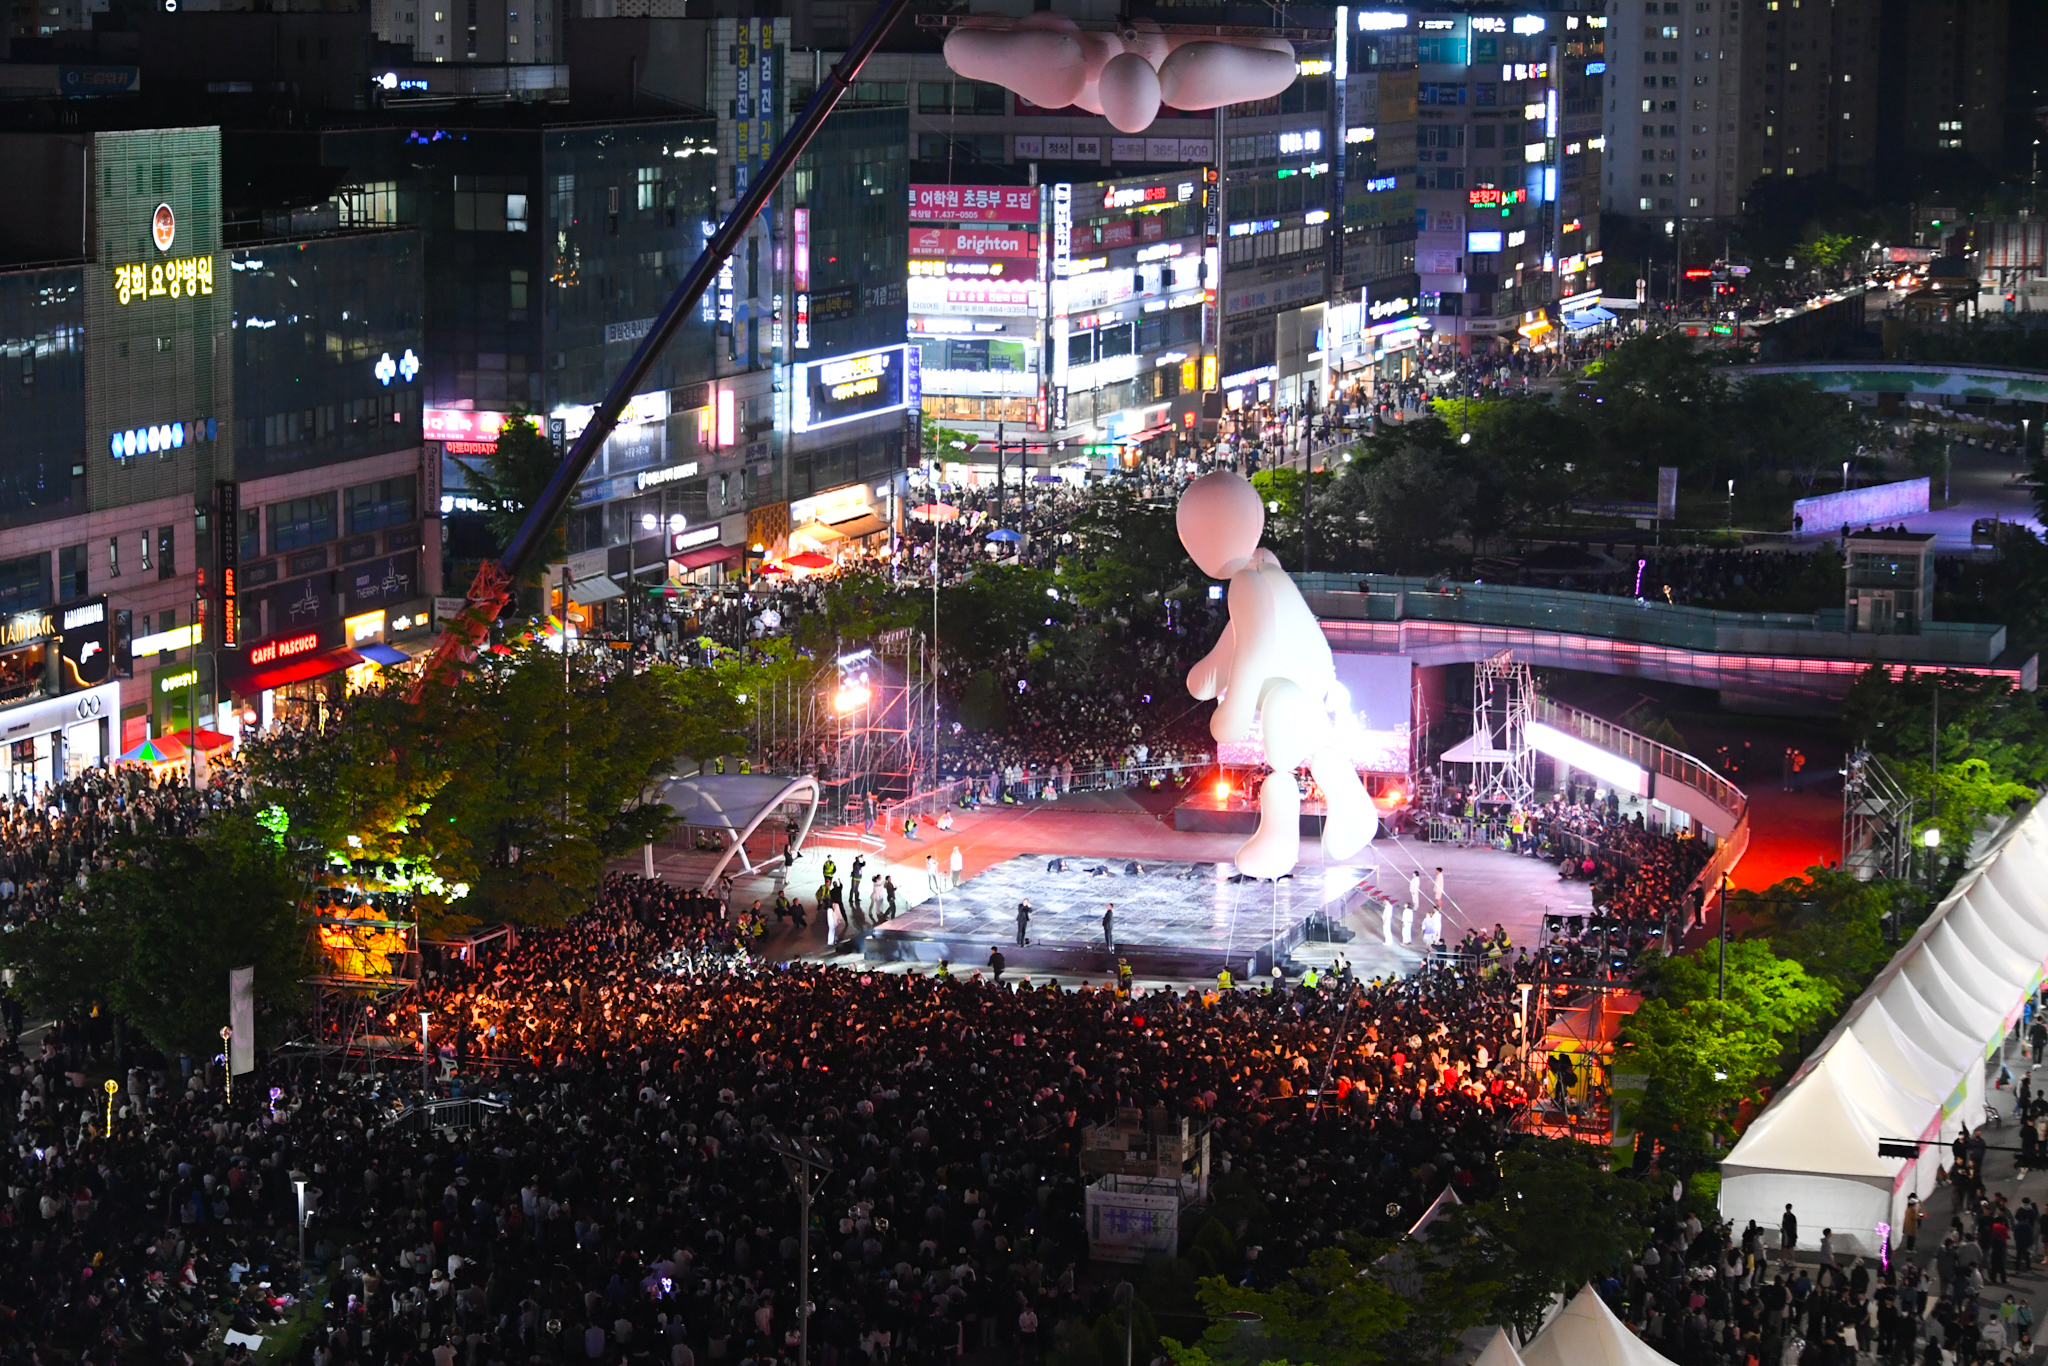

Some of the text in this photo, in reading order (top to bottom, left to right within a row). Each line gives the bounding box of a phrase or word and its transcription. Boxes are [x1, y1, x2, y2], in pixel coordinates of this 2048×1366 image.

[1472, 17, 1506, 32] 이투스
[739, 25, 748, 113] 건강검진
[1048, 143, 1069, 154] 정상
[921, 190, 958, 208] 어학원
[963, 190, 1001, 209] 초등부
[1006, 193, 1031, 209] 모집
[1469, 190, 1501, 203] 보청기
[909, 211, 978, 221] 육상담 T.437-0505
[957, 235, 1018, 254] Brighton
[115, 255, 213, 305] 경희 요양병원
[912, 301, 940, 310] 다이어트
[949, 303, 1026, 315] 예약 및 문의 484-3355
[356, 585, 380, 600] THERAPY
[226, 599, 235, 643] PASCUCCI
[251, 633, 318, 665] CAFFÉ PASCUCCI
